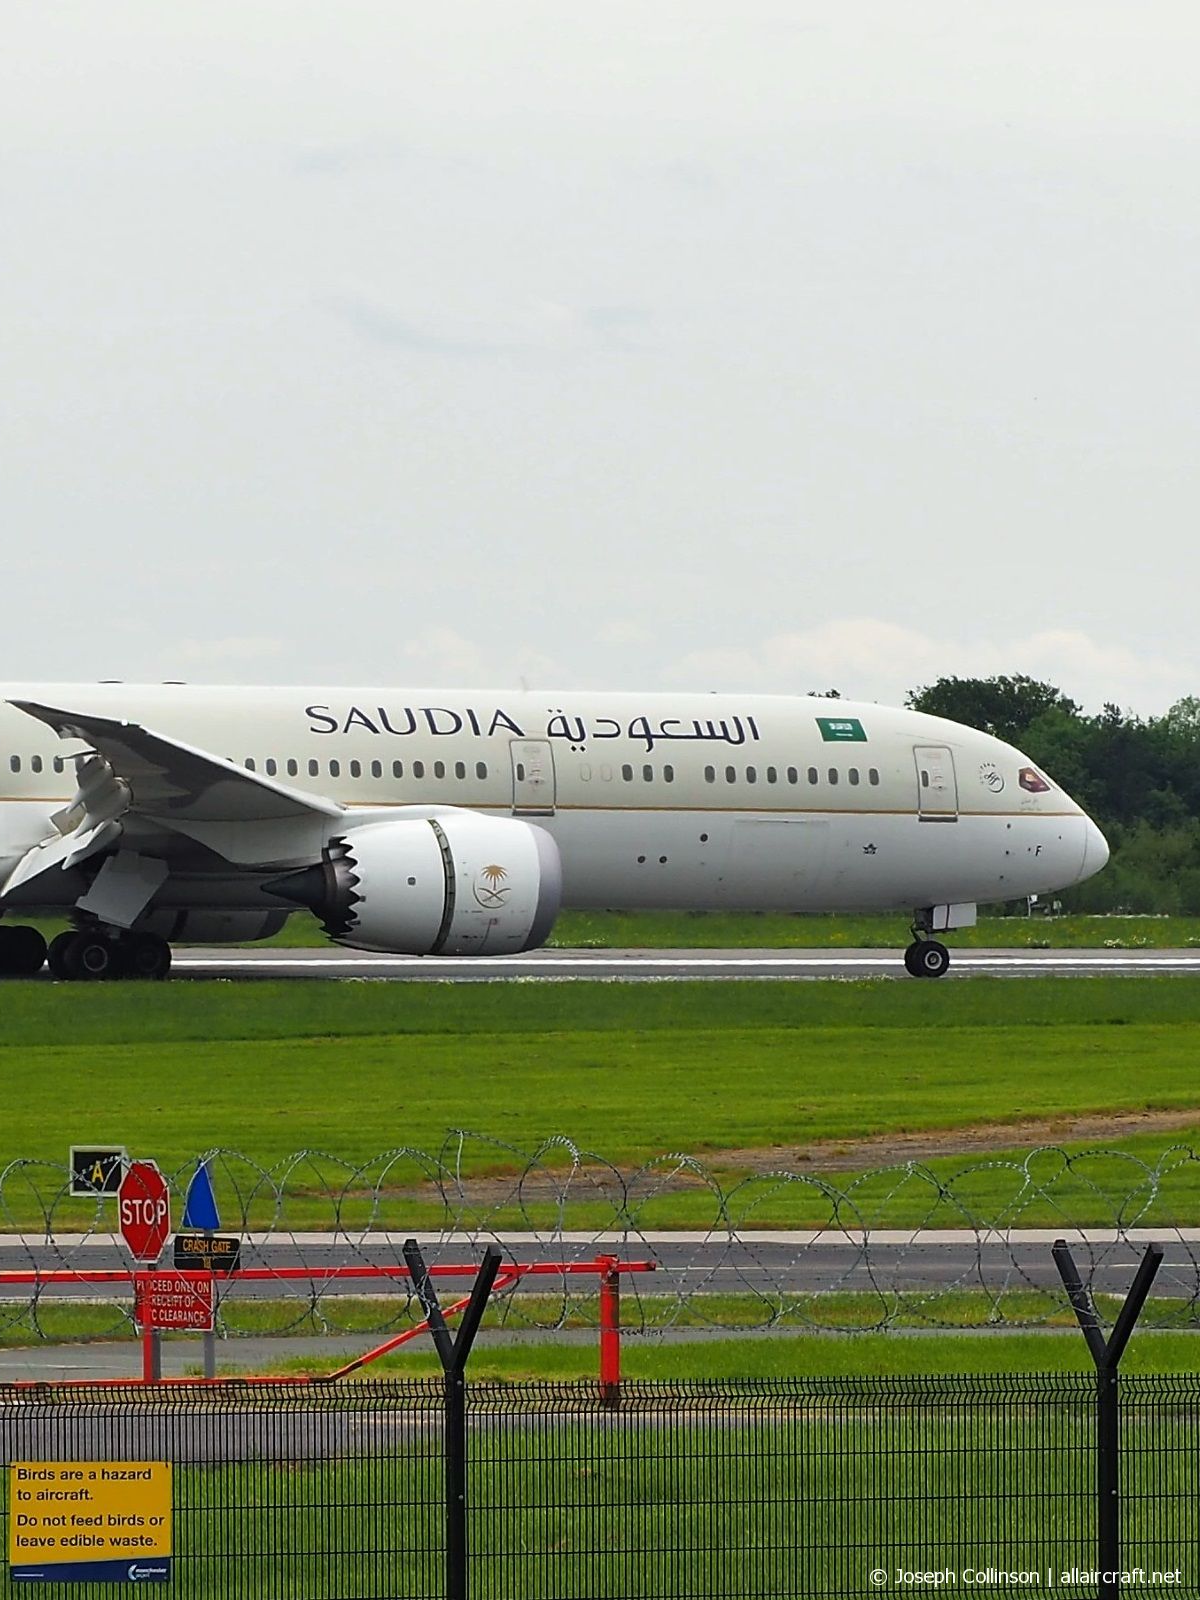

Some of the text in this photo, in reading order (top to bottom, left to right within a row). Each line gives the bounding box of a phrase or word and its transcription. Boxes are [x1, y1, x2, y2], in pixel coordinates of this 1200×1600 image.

[304, 705, 526, 737] SAUDIA
[546, 708, 761, 753] السعودية
[1035, 845, 1042, 856] F
[91, 1160, 104, 1183] A
[121, 1199, 167, 1226] STOP
[182, 1238, 232, 1254] CRASH GATE
[136, 1280, 210, 1294] PCEED ONLY ON
[151, 1294, 196, 1308] RECEIPT OF
[158, 1309, 207, 1324] CLEARANCE
[16, 1468, 152, 1481] Birds are a hazard
[17, 1488, 94, 1501] to aircraft.
[16, 1514, 165, 1527] Do not feed birds or
[16, 1534, 158, 1548] leave edible waste.
